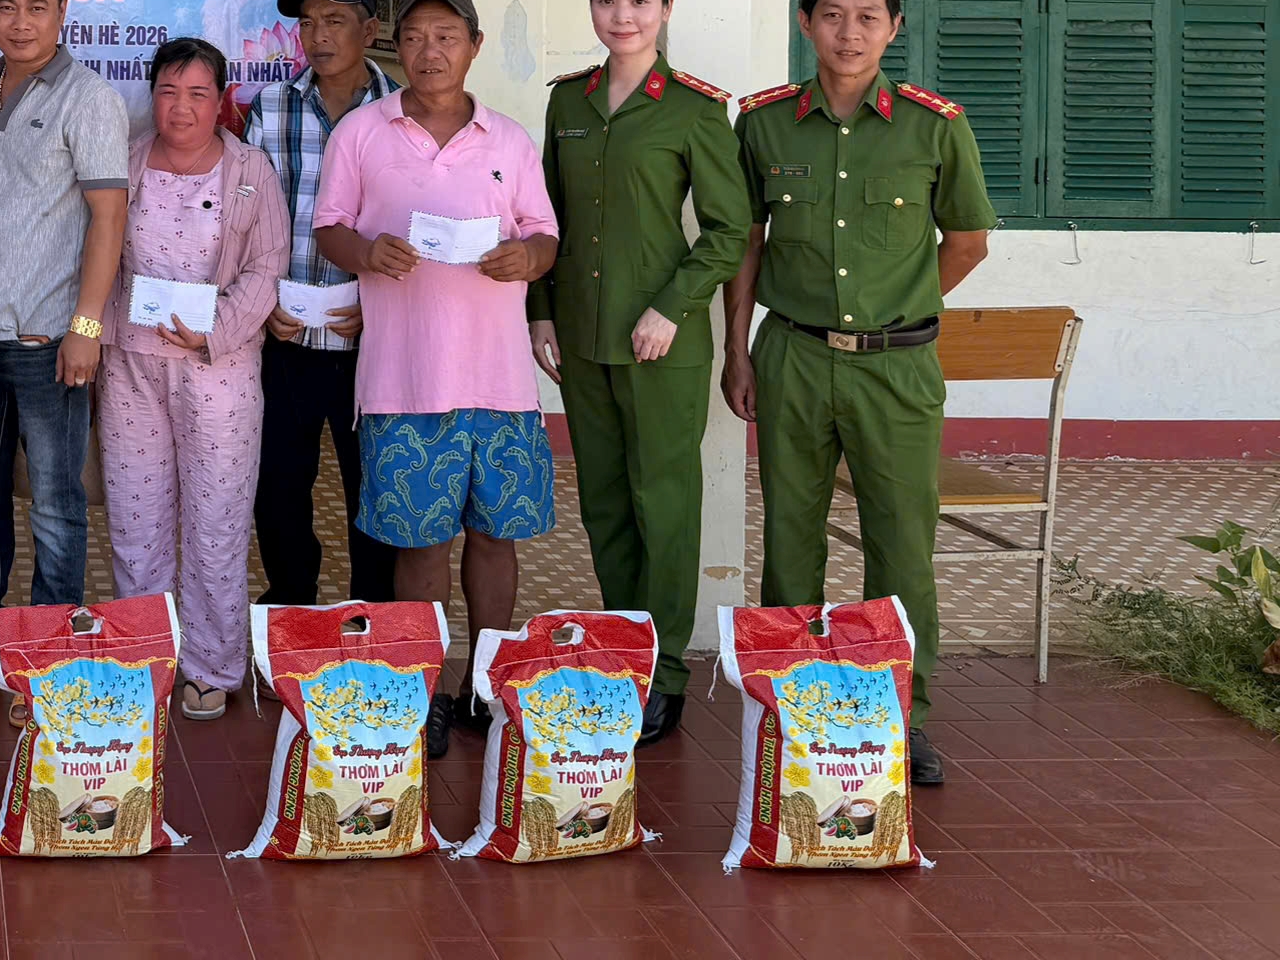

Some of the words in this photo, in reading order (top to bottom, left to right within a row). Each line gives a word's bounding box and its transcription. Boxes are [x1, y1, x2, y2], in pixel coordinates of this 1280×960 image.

[59, 20, 93, 49] YỆN
[98, 21, 120, 45] HÈ
[125, 25, 168, 46] 2026
[106, 53, 153, 81] NHẤT
[247, 54, 293, 82] NHẤT
[61, 761, 101, 776] THƠM
[106, 756, 127, 773] LÀI
[291, 739, 305, 786] THƯỢNG
[339, 764, 380, 779] THƠM
[384, 759, 404, 777] LÀI
[506, 746, 520, 794] THƯỢNG
[557, 769, 598, 784] THƠM
[601, 765, 623, 783] LÀI
[762, 735, 777, 790] THƯỢNG
[816, 762, 858, 776] THƠM
[860, 758, 883, 776] LÀI
[83, 777, 106, 790] VIP
[362, 782, 385, 793] VIP
[580, 787, 603, 798] VIP
[841, 780, 864, 792] VIP
[283, 784, 297, 820] HẠNG
[502, 794, 514, 828] HẠNG
[758, 789, 773, 825] HẠNG
